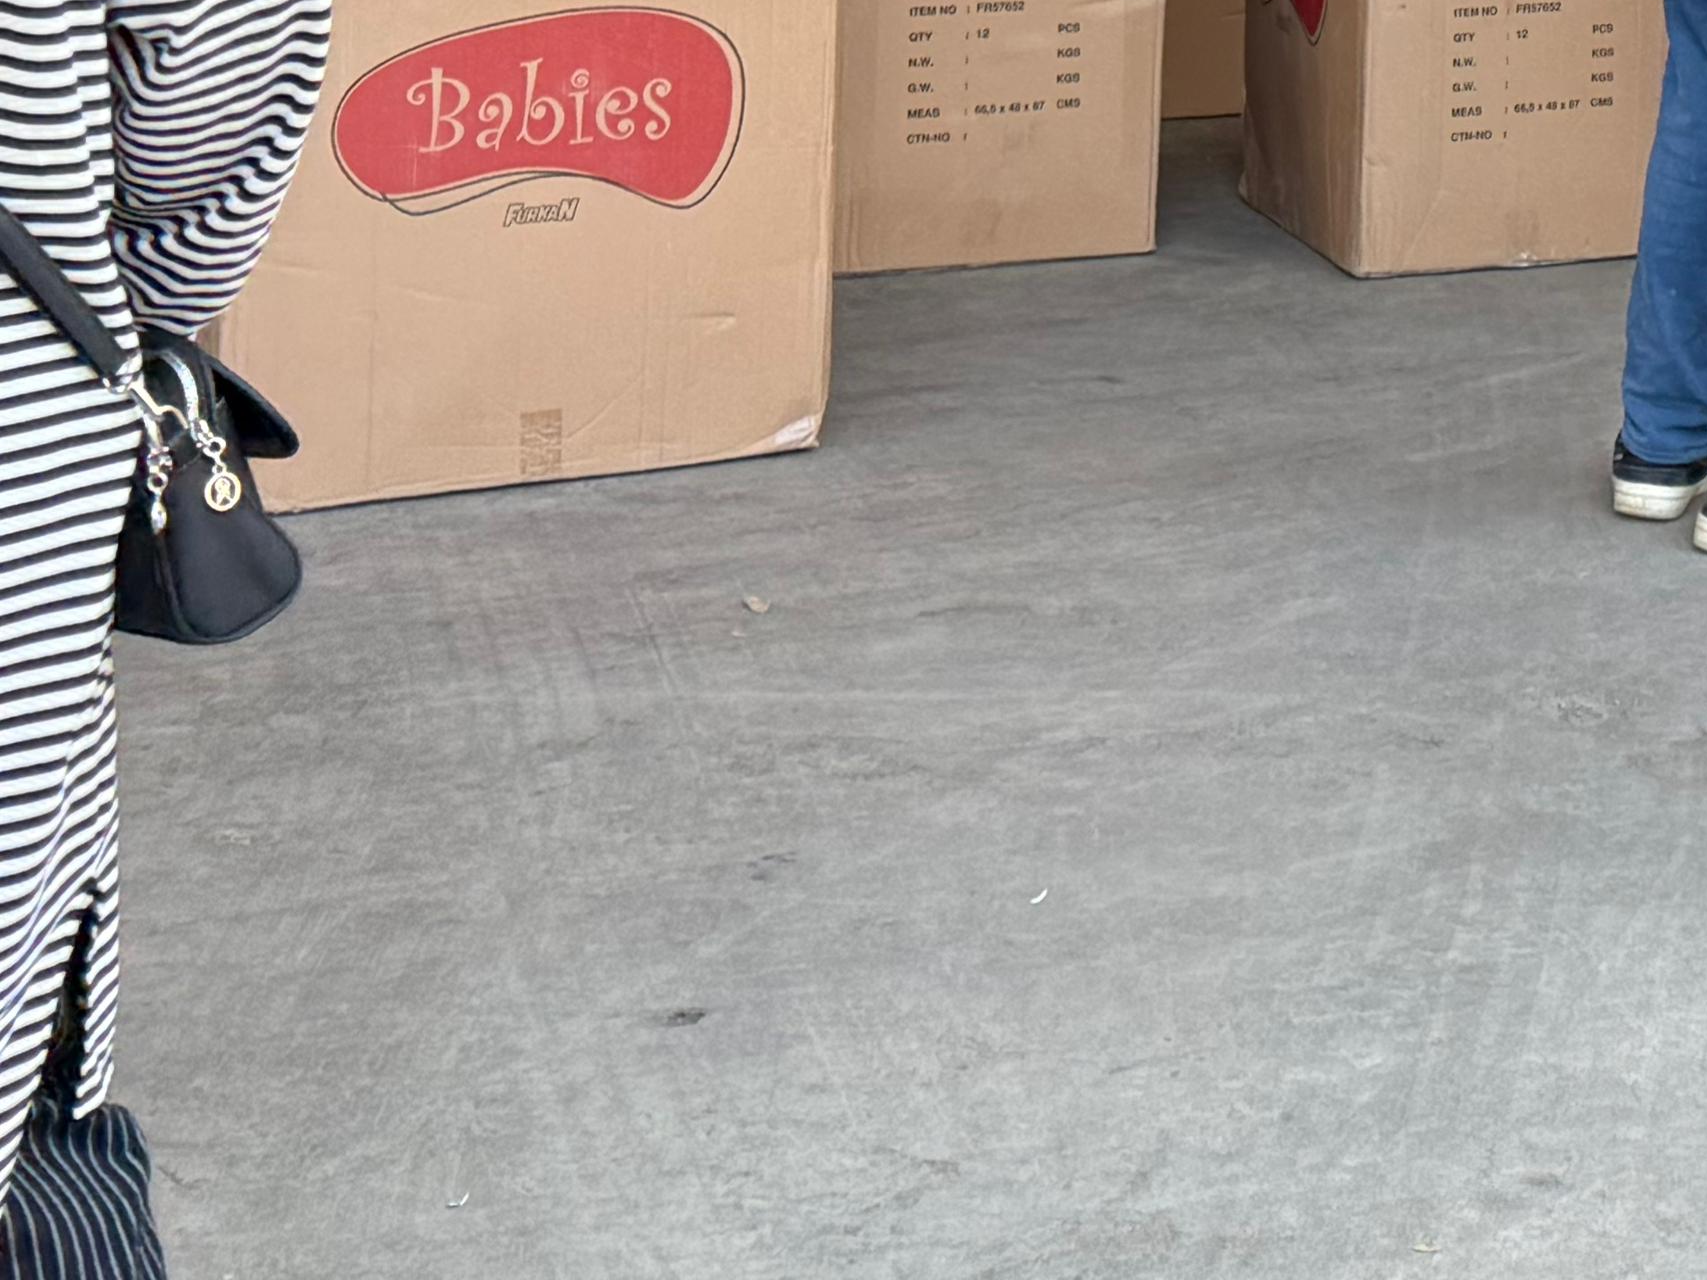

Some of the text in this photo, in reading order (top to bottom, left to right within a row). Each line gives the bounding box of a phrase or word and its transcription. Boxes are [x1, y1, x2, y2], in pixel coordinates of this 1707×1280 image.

[909, 6, 937, 17] ITEM
[940, 4, 957, 15] NO
[1454, 7, 1479, 18] ITEM
[1481, 6, 1497, 17] NO
[908, 31, 933, 42] QTY
[976, 28, 990, 39] 12
[1453, 32, 1475, 42] QTY
[1516, 29, 1528, 39] 12
[908, 56, 934, 68] N.W.
[1452, 56, 1476, 67] N.W.
[1591, 72, 1614, 82] KGS
[406, 57, 672, 154] Babies
